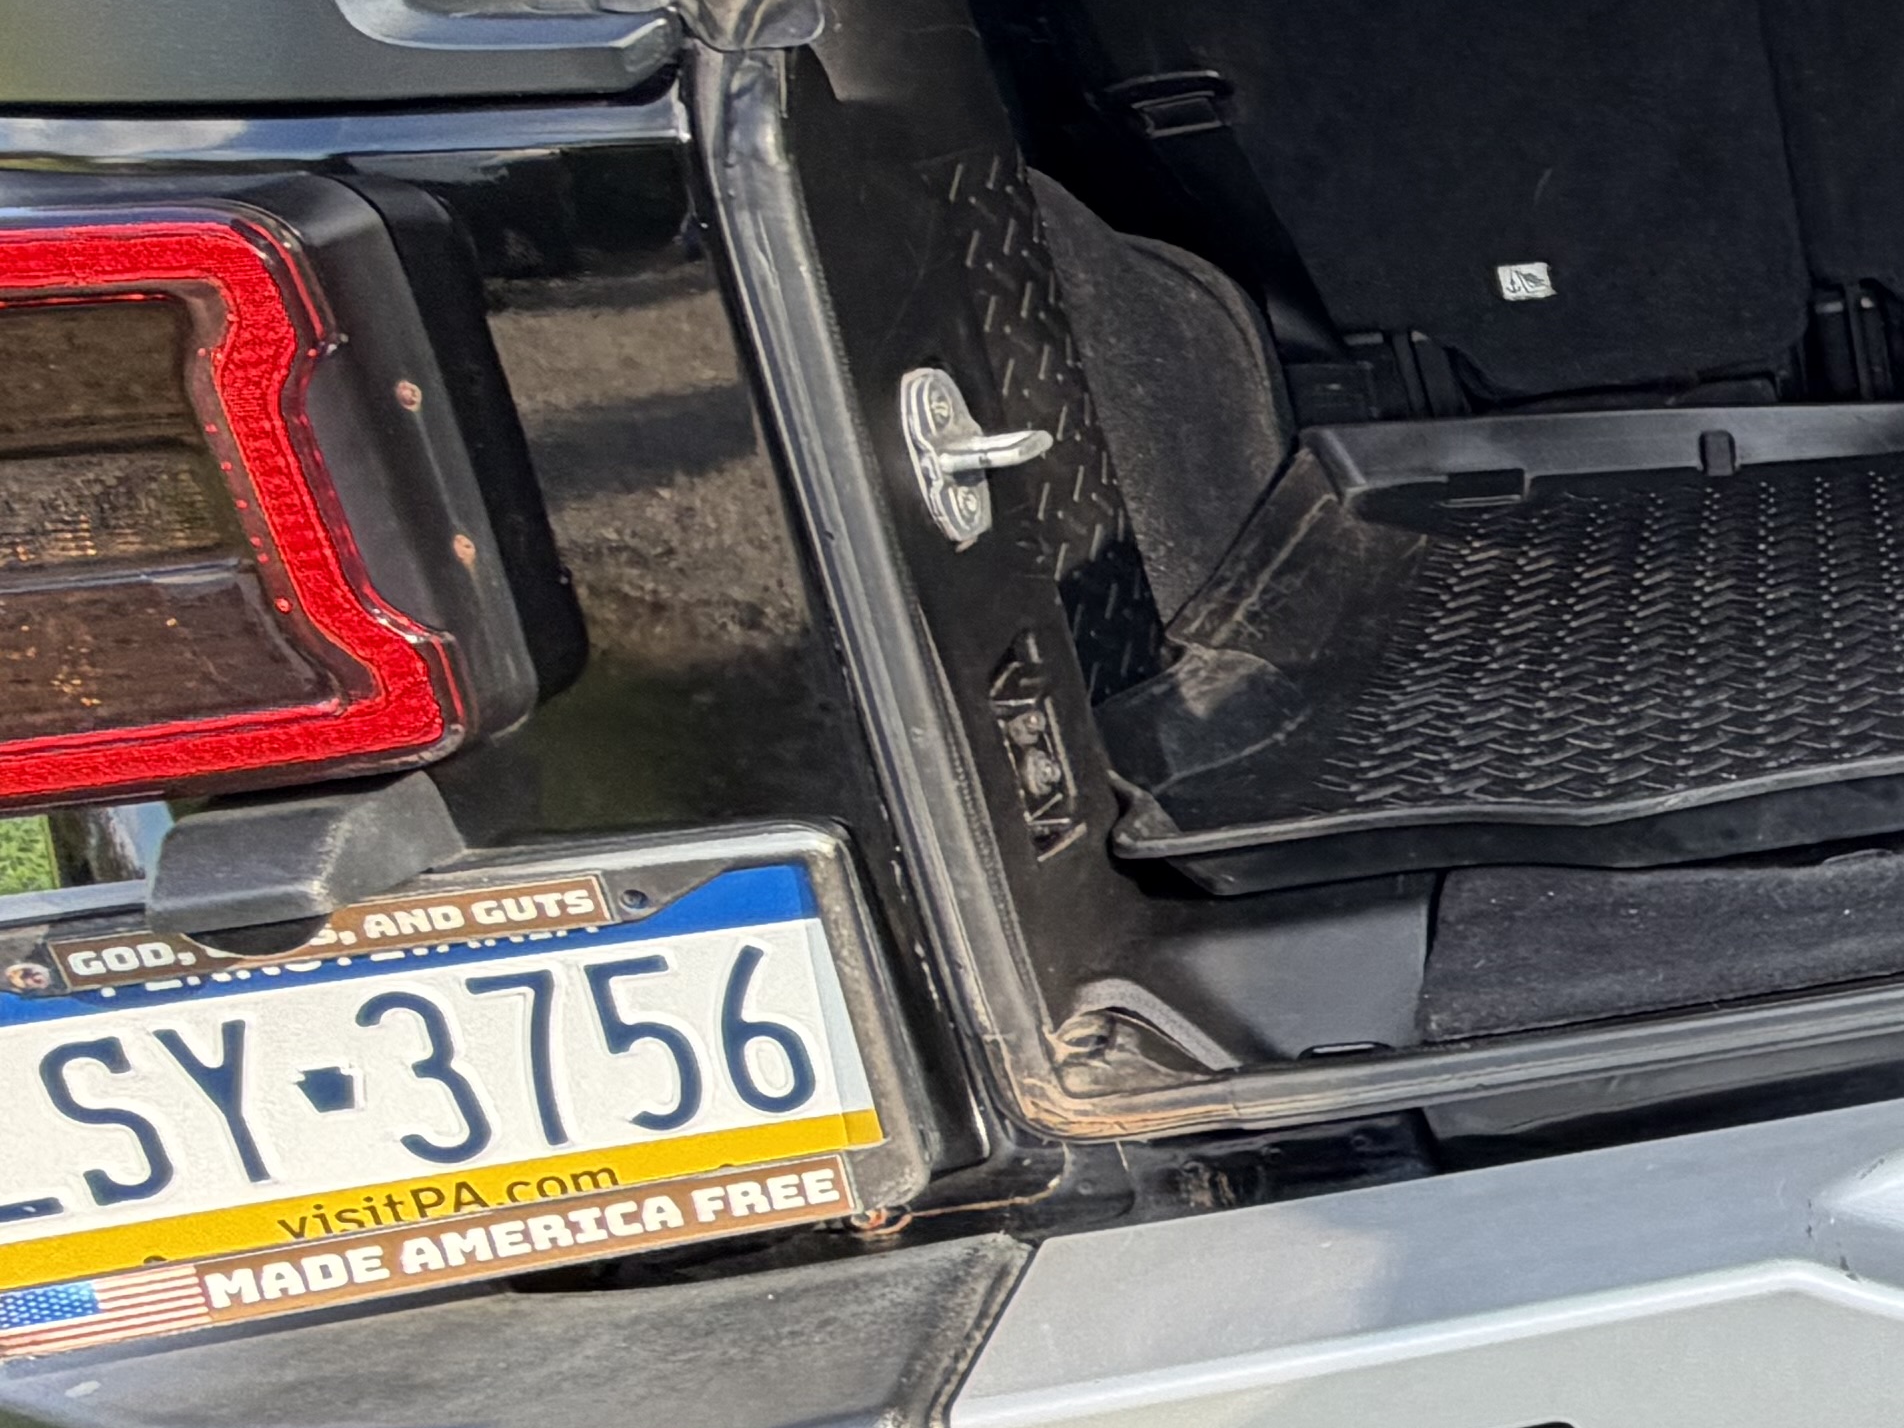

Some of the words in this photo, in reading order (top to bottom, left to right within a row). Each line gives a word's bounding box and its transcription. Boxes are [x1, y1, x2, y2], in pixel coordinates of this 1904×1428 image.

[67, 941, 197, 976] GOD,
[363, 904, 466, 939] AND
[471, 889, 595, 925] GUTS
[0, 1019, 271, 1222] SY
[355, 944, 816, 1164] 3756
[204, 1245, 391, 1310] MADE
[401, 1195, 684, 1275] AMERICA
[691, 1168, 840, 1223] FREE
[277, 1166, 620, 1240] visitPA.com
